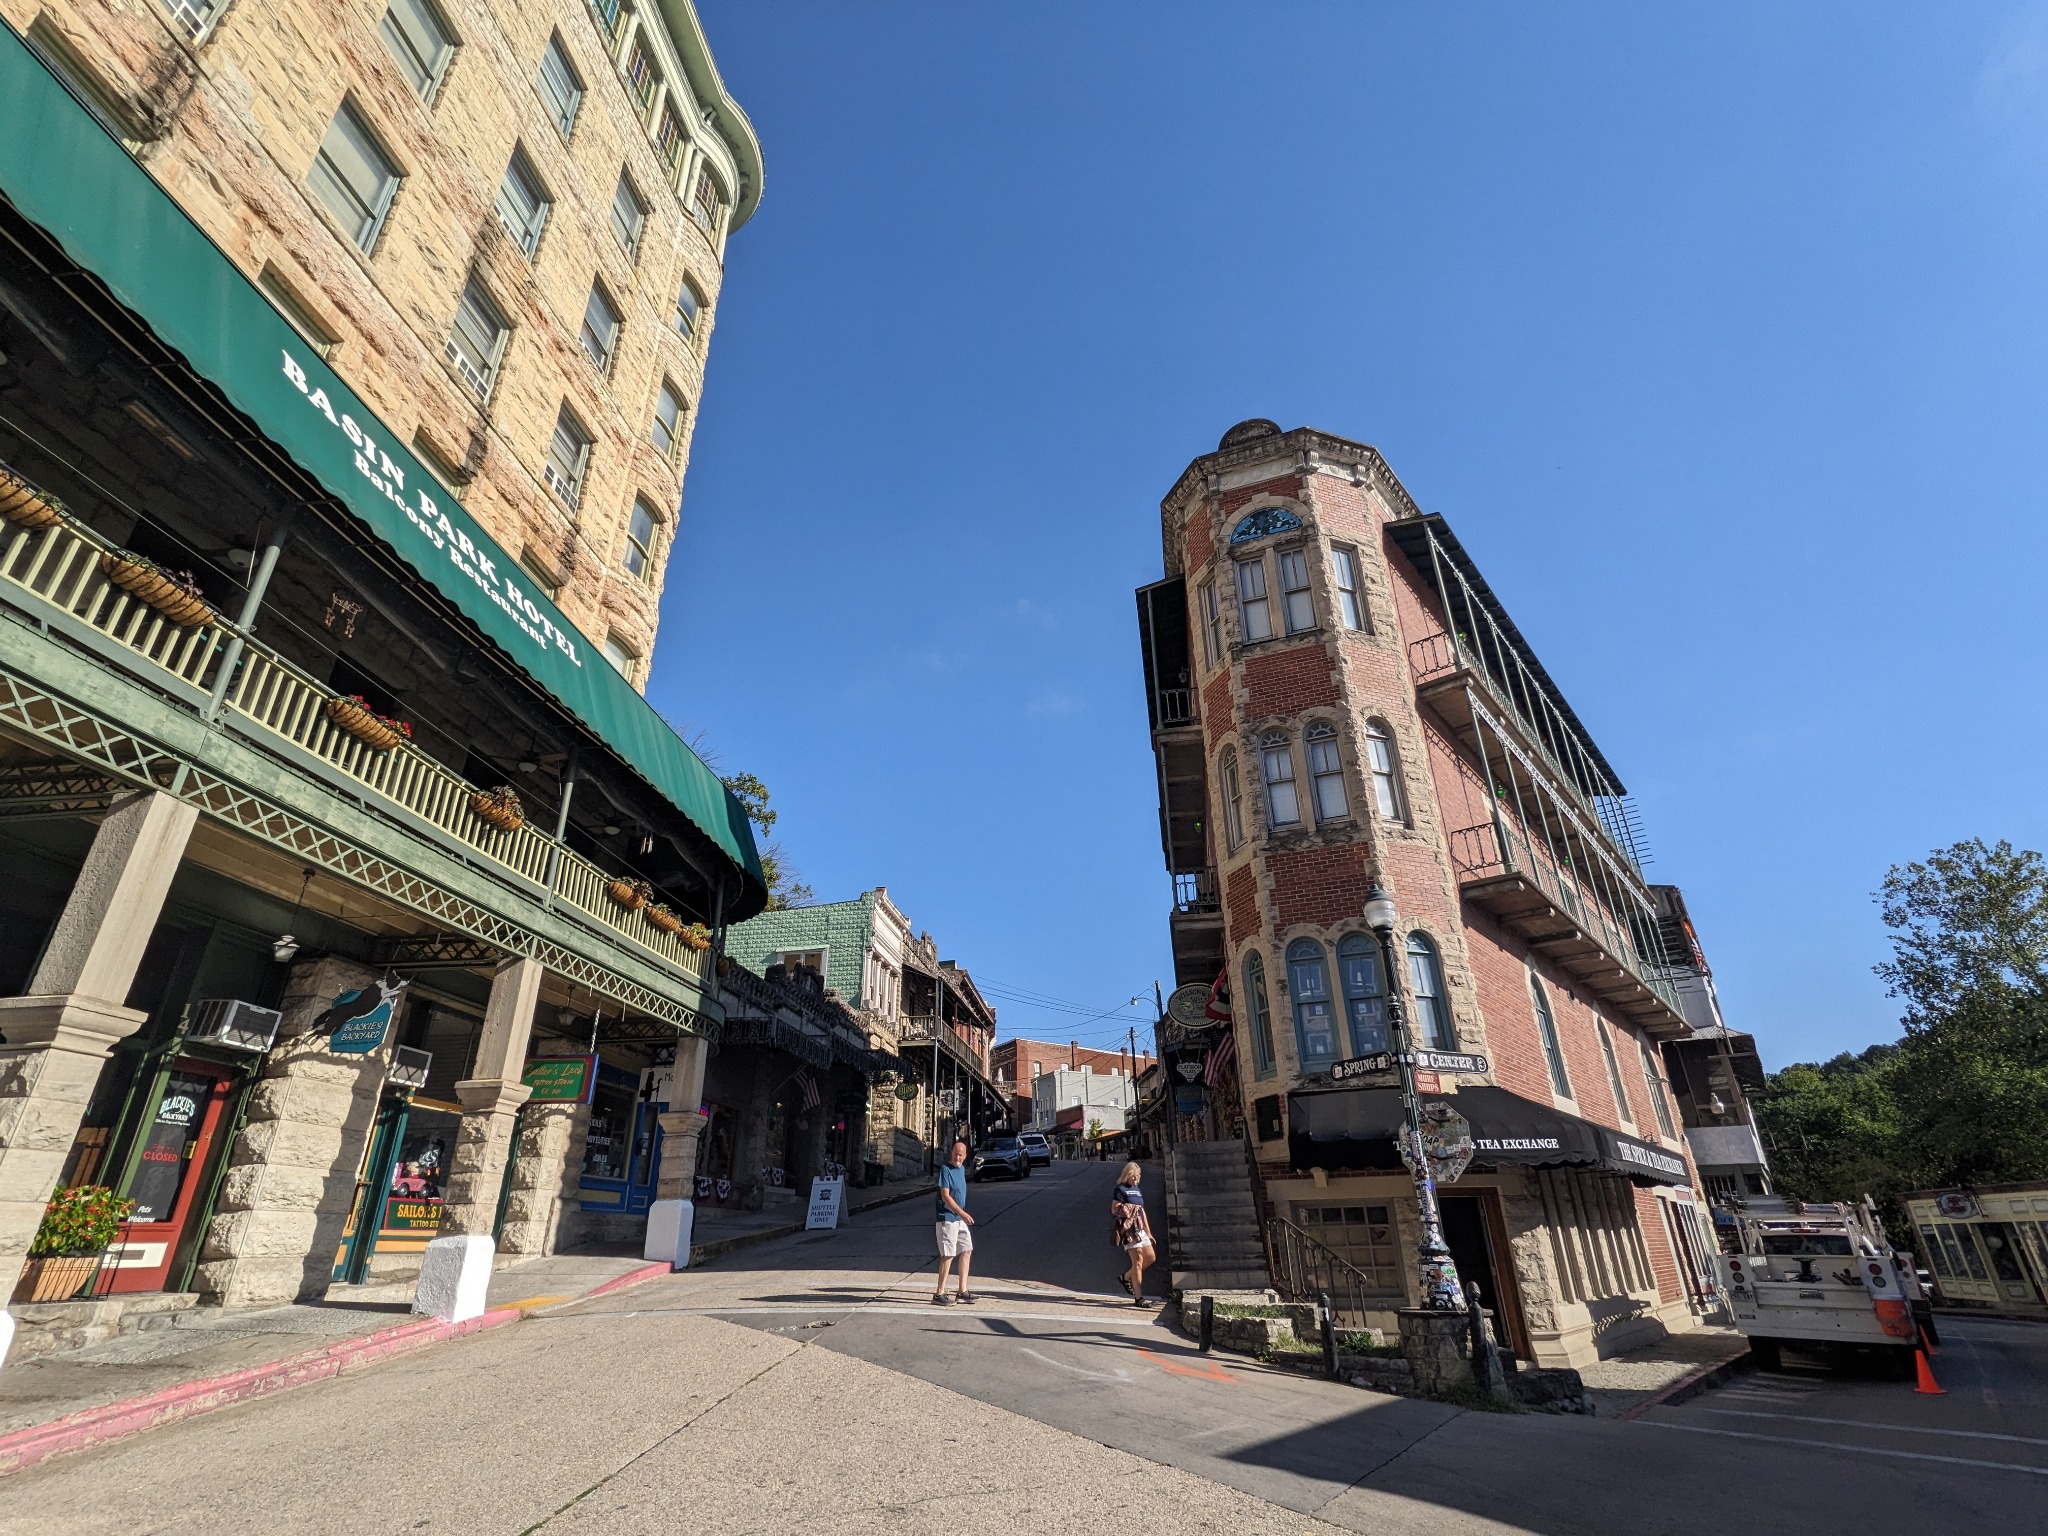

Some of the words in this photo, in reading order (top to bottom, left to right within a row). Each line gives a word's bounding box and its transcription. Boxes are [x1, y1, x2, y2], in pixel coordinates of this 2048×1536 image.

[282, 349, 405, 490] BASIN
[417, 488, 500, 586] PARK
[505, 577, 581, 668] HOTEL
[354, 449, 444, 550] Balcony
[448, 544, 547, 649] Restaurant
[344, 1021, 384, 1032] BLACKIE'S
[341, 1031, 380, 1041] BACKYARD
[1344, 1056, 1377, 1077] SPRING
[1430, 1053, 1475, 1071] CENTER
[1417, 1073, 1436, 1083] MORE
[1418, 1082, 1440, 1093] SHOPS
[159, 1095, 195, 1117] BLACKIE'S
[1477, 1139, 1501, 1149] TEA
[1502, 1138, 1559, 1149] EXCHANGE
[143, 1151, 178, 1162] CLOSED
[137, 1205, 153, 1213] Pets
[410, 1220, 429, 1228] TATTOO
[430, 1220, 439, 1228] STU
